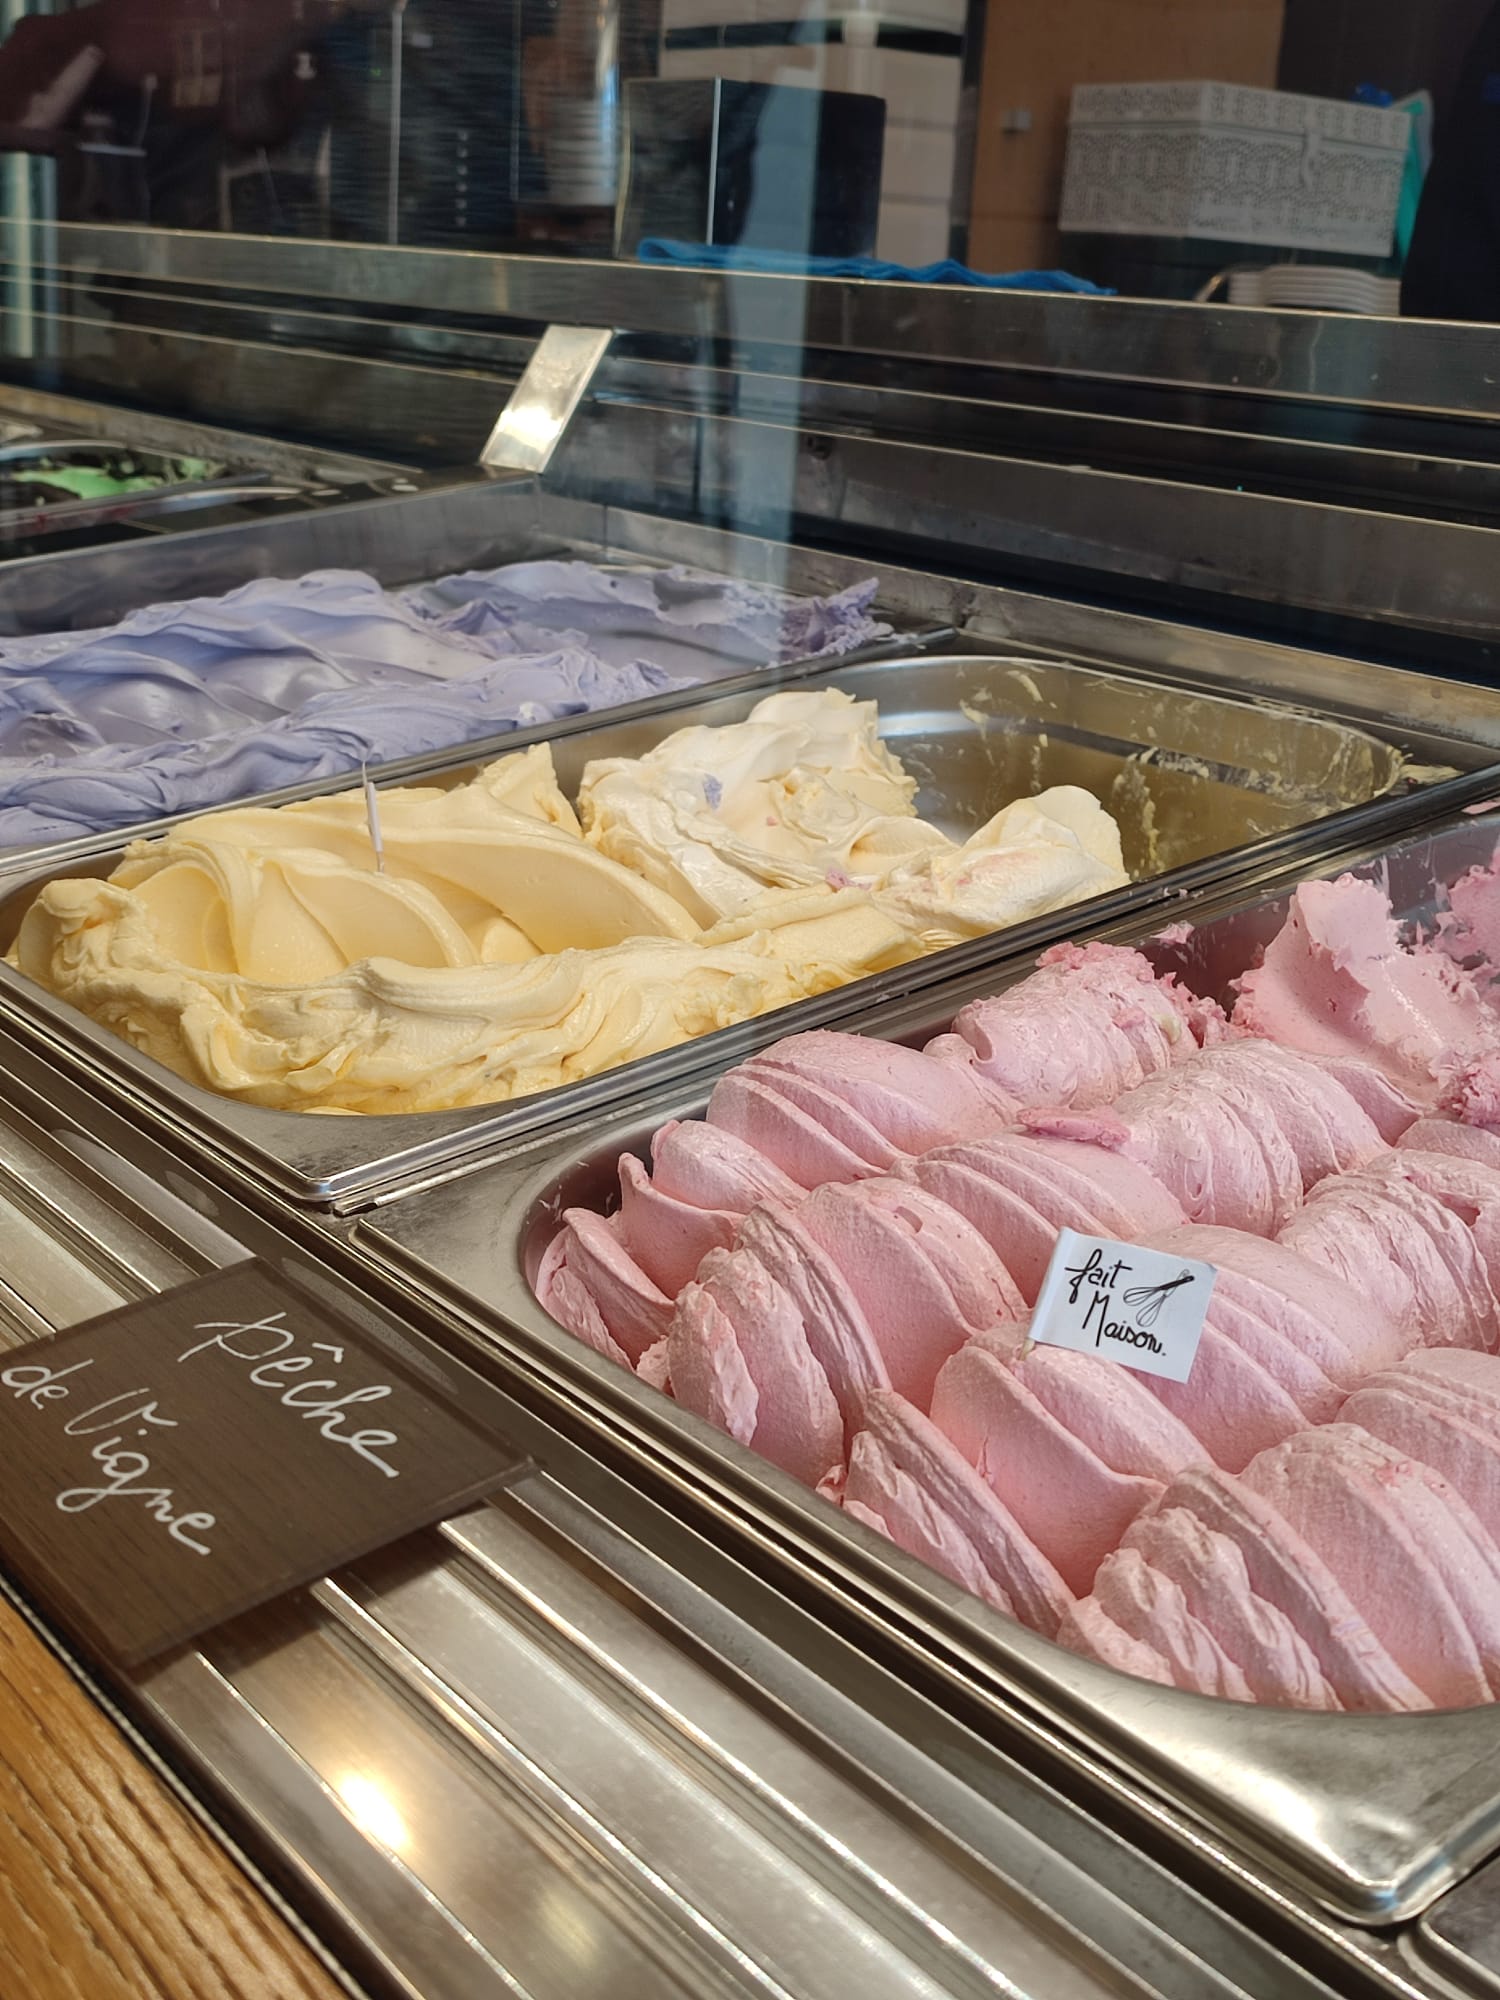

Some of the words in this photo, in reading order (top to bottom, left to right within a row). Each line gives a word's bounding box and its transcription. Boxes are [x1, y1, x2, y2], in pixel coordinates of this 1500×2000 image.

[1064, 1248, 1133, 1304] fait
[1, 1359, 94, 1410] de
[56, 1387, 216, 1556] Vigne
